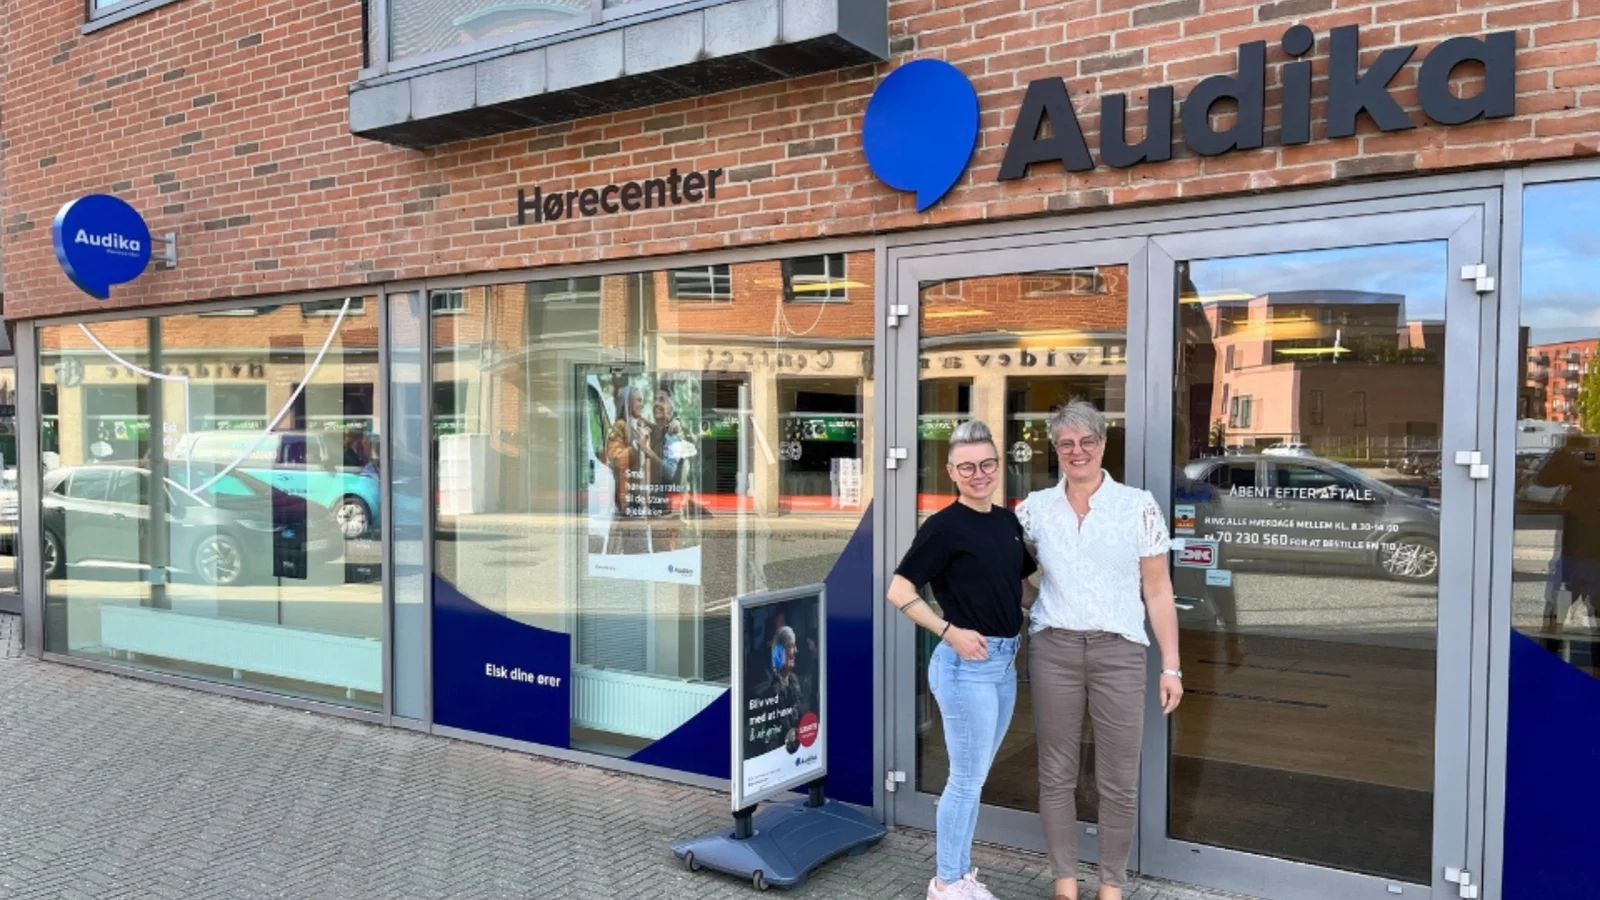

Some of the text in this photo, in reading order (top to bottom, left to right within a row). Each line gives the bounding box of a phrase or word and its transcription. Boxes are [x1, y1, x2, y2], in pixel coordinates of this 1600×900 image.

[997, 24, 1517, 182] Audika
[517, 167, 723, 225] Hørecenter
[74, 228, 141, 252] Audika
[1229, 483, 1272, 498] ÅBENT
[1275, 487, 1316, 499] EFTER
[1204, 517, 1226, 526] RING
[1226, 518, 1247, 526] ALLE
[1249, 519, 1294, 528] HVERDAGE
[1296, 520, 1333, 529] MELLEM
[1335, 522, 1349, 530] KL.
[1216, 531, 1232, 543] 70
[1235, 532, 1259, 544] 230
[1262, 533, 1288, 546] 560
[1289, 538, 1308, 547] FOR
[1309, 540, 1321, 548] AT
[1322, 540, 1364, 549] BESTILLE
[485, 662, 508, 679] Elsk
[510, 667, 535, 683] dine
[765, 695, 779, 706] ved
[749, 712, 767, 725] med
[768, 711, 776, 721] at
